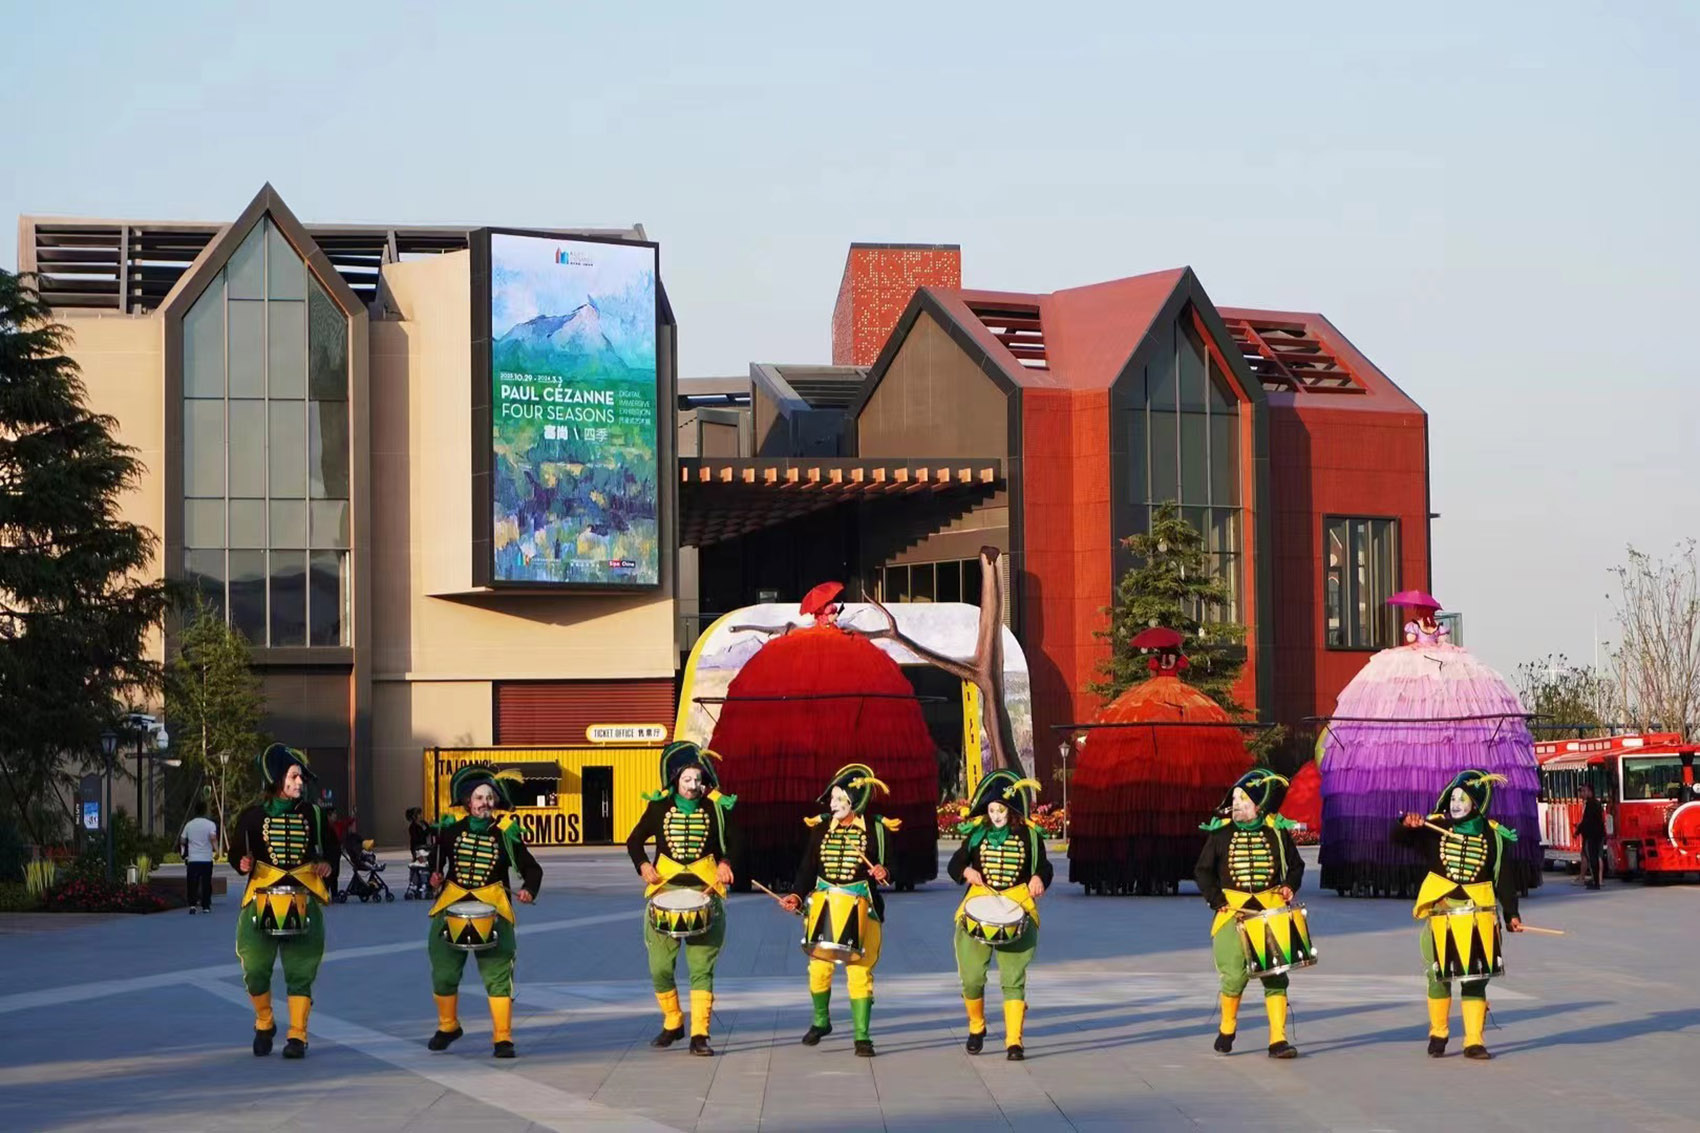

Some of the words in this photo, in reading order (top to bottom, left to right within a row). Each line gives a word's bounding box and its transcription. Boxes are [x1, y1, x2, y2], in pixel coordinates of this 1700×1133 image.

[501, 384, 539, 401] PAUL
[543, 383, 615, 405] CÉZANNE
[502, 403, 543, 420] FOUR
[546, 405, 615, 423] SEASONS
[584, 427, 609, 442] 四季
[594, 728, 613, 738] TICKET
[614, 728, 634, 738] OFFICE
[496, 813, 580, 844] SMOS
